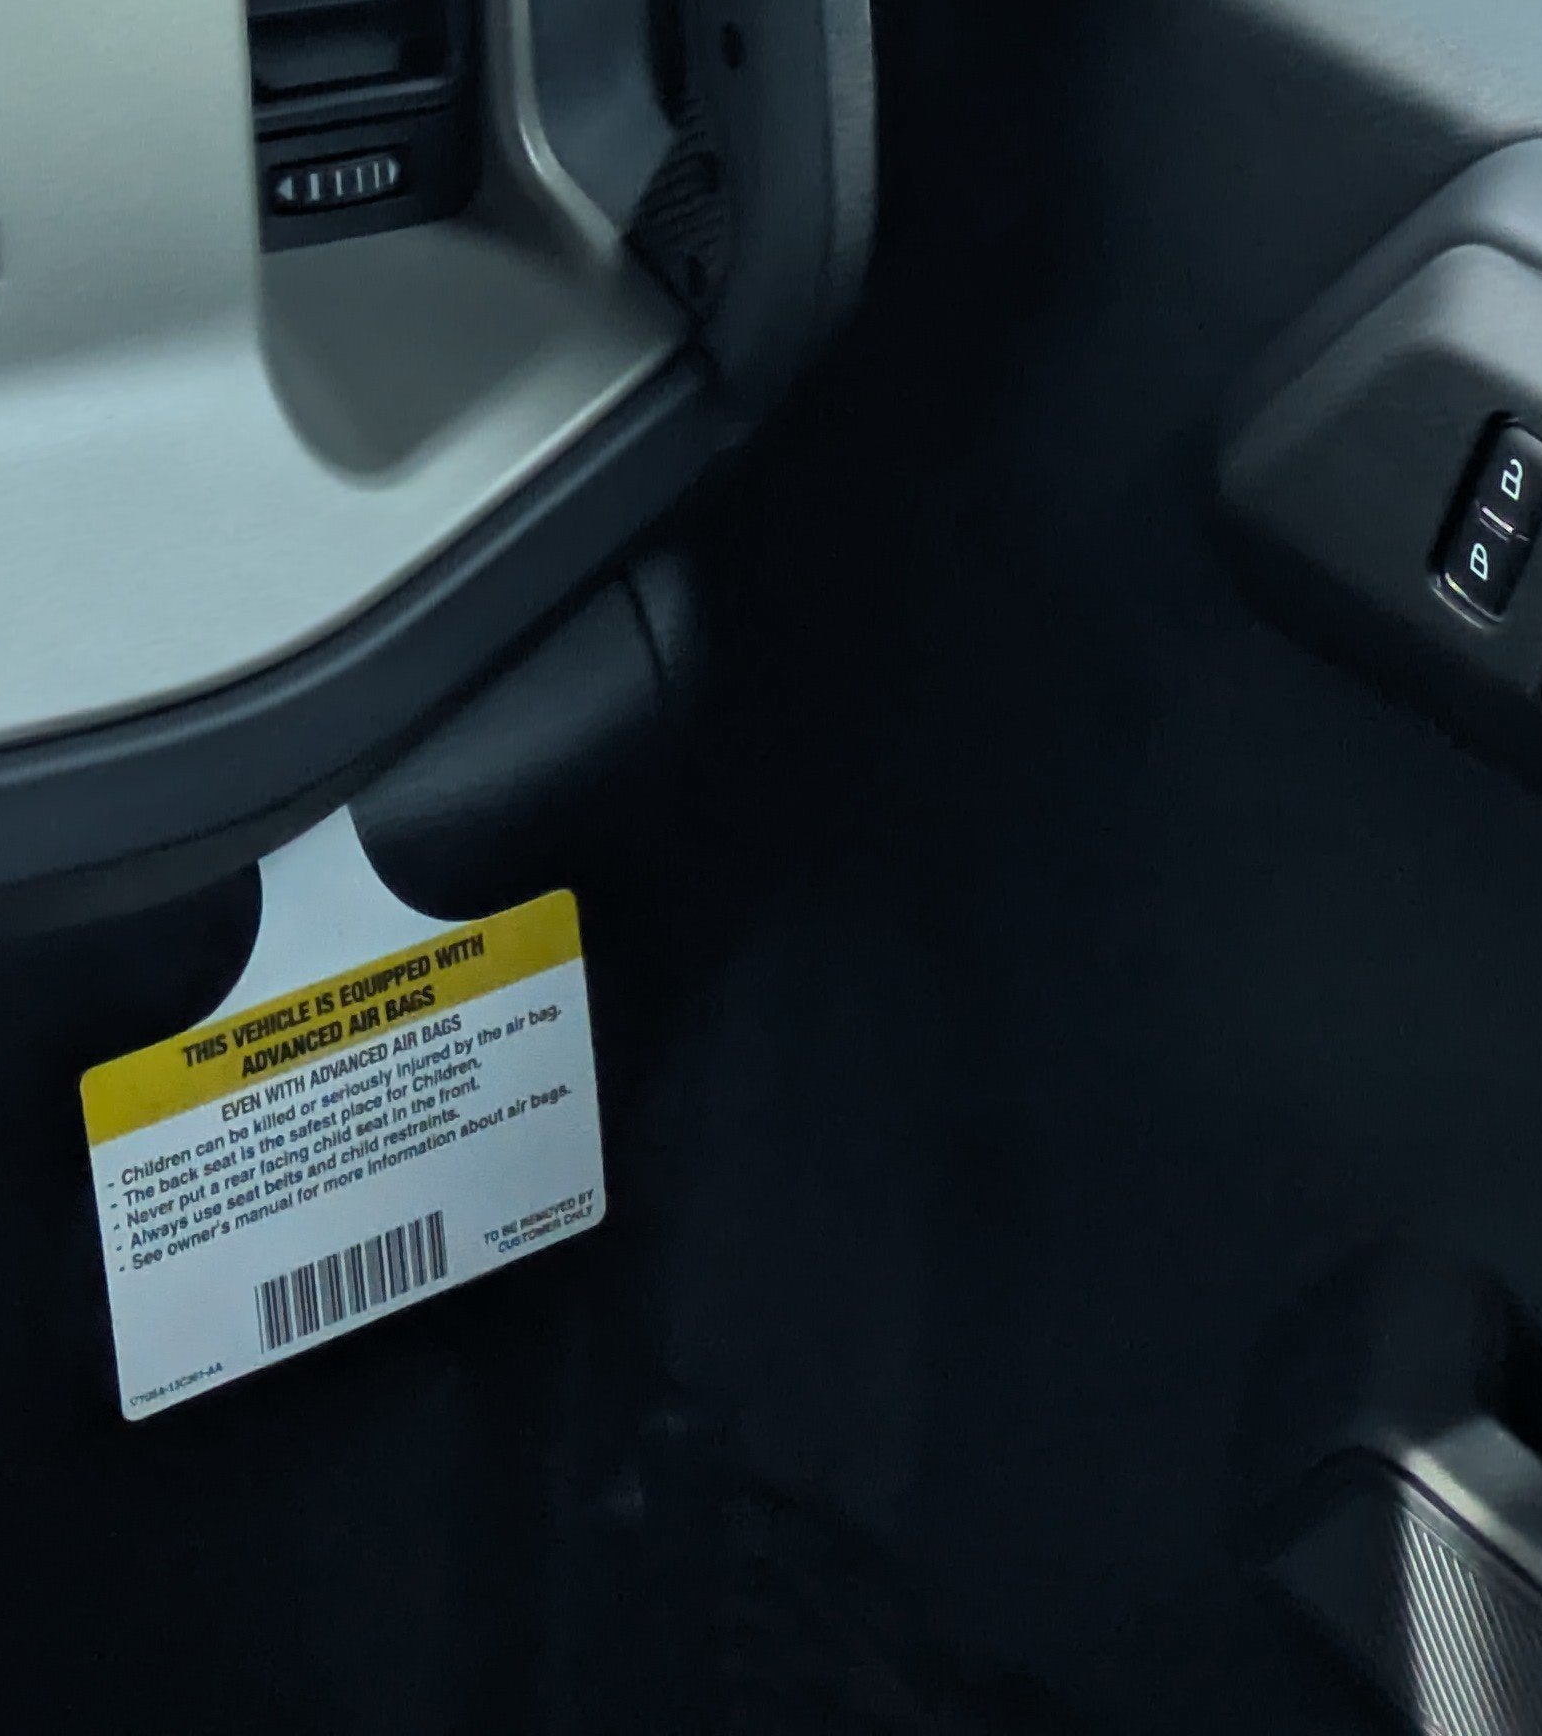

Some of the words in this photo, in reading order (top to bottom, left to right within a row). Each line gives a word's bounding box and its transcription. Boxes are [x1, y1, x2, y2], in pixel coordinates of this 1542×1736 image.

[183, 1031, 228, 1068] THIS
[232, 1000, 311, 1049] VEHICLE
[315, 990, 335, 1017] IS
[339, 953, 432, 1007] EQUIPPED
[435, 932, 484, 971] WITH
[220, 1090, 261, 1123] EVEN
[264, 1073, 305, 1106] WITH
[308, 1041, 388, 1088] ADVANCED
[391, 1029, 417, 1055] AIR
[421, 1012, 461, 1044] BAGS
[240, 1019, 343, 1078] ADVANCED
[348, 1005, 380, 1036] AIR
[384, 983, 435, 1023] BAGS
[120, 1145, 191, 1186] Children
[195, 1135, 224, 1157] can
[228, 1122, 249, 1144] be
[253, 1104, 296, 1135] killed
[300, 1099, 317, 1116] or
[320, 1066, 393, 1111] seriously
[453, 1033, 474, 1059] by
[476, 1023, 501, 1046] the
[505, 1013, 525, 1035] air
[528, 999, 562, 1029] bag.
[123, 1181, 155, 1207] The
[159, 1164, 198, 1193] back
[202, 1150, 237, 1176] seat
[259, 1131, 285, 1154] the
[288, 1111, 336, 1142] safest
[340, 1093, 383, 1125] place
[386, 1081, 407, 1103] for
[411, 1052, 481, 1093] Children.
[126, 1195, 175, 1228] Never
[178, 1184, 206, 1210] put
[209, 1180, 220, 1195] a
[223, 1165, 256, 1190] rear
[260, 1142, 309, 1178] facing
[312, 1125, 351, 1155] child
[355, 1111, 388, 1137] seat
[411, 1091, 435, 1115] the
[439, 1073, 480, 1104] front.
[129, 1213, 188, 1252] Always
[192, 1202, 222, 1224] use
[226, 1184, 260, 1210] seat
[263, 1166, 303, 1195] belts
[306, 1153, 337, 1177] and
[340, 1134, 379, 1165] child
[382, 1103, 460, 1147] restraints.
[131, 1243, 164, 1271] See
[166, 1215, 230, 1256] owner's
[233, 1191, 293, 1229] manual
[296, 1180, 320, 1205] for
[322, 1165, 363, 1194] more
[459, 1106, 503, 1138] about
[506, 1095, 528, 1119] air
[529, 1079, 572, 1113] bags.
